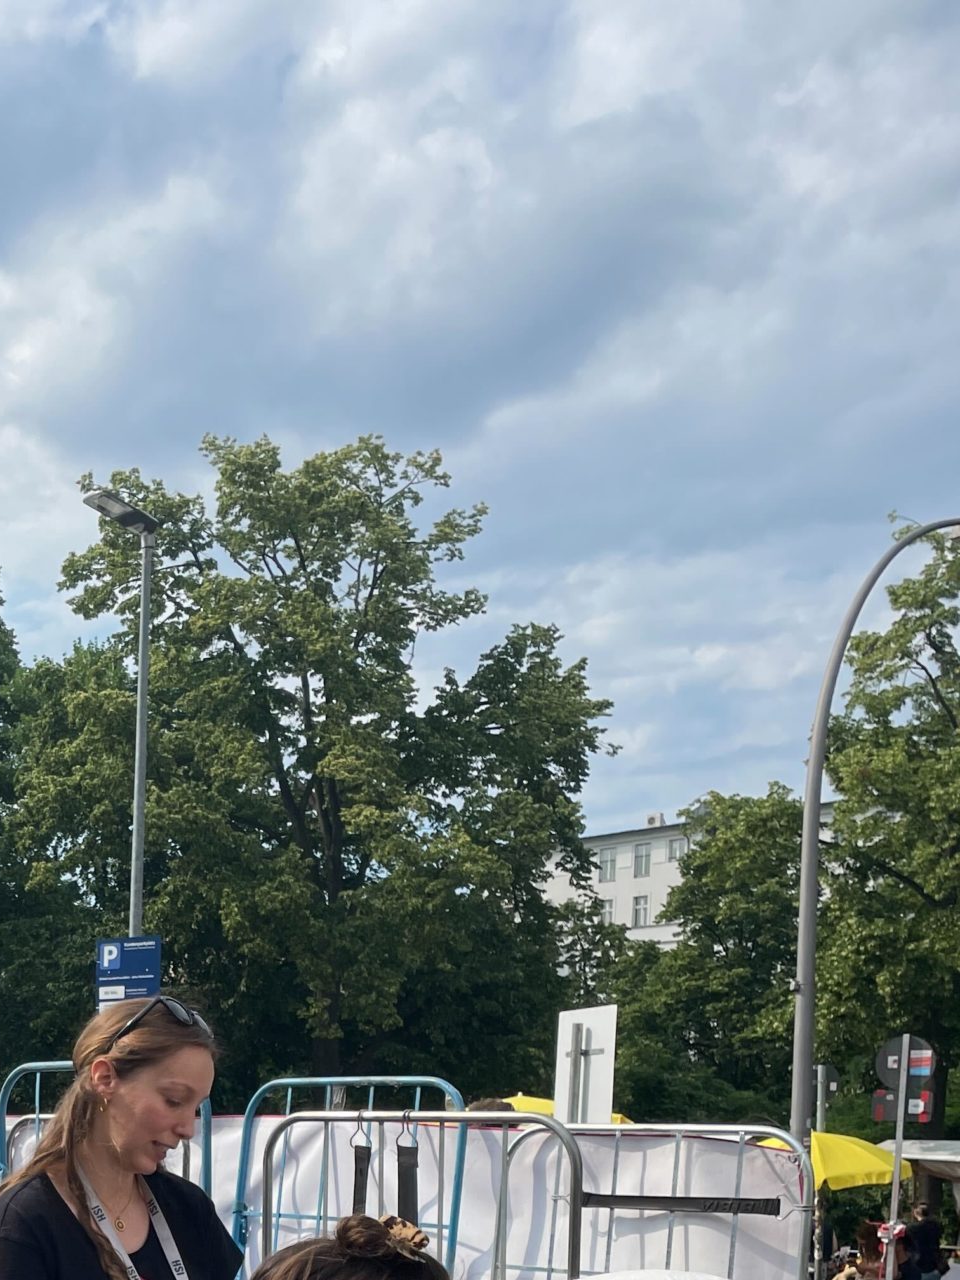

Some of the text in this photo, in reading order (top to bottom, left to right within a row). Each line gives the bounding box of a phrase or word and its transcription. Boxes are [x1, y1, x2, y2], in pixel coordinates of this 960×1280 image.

[103, 945, 118, 968] P
[91, 1204, 107, 1222] ISH
[171, 1259, 185, 1276] ISH
